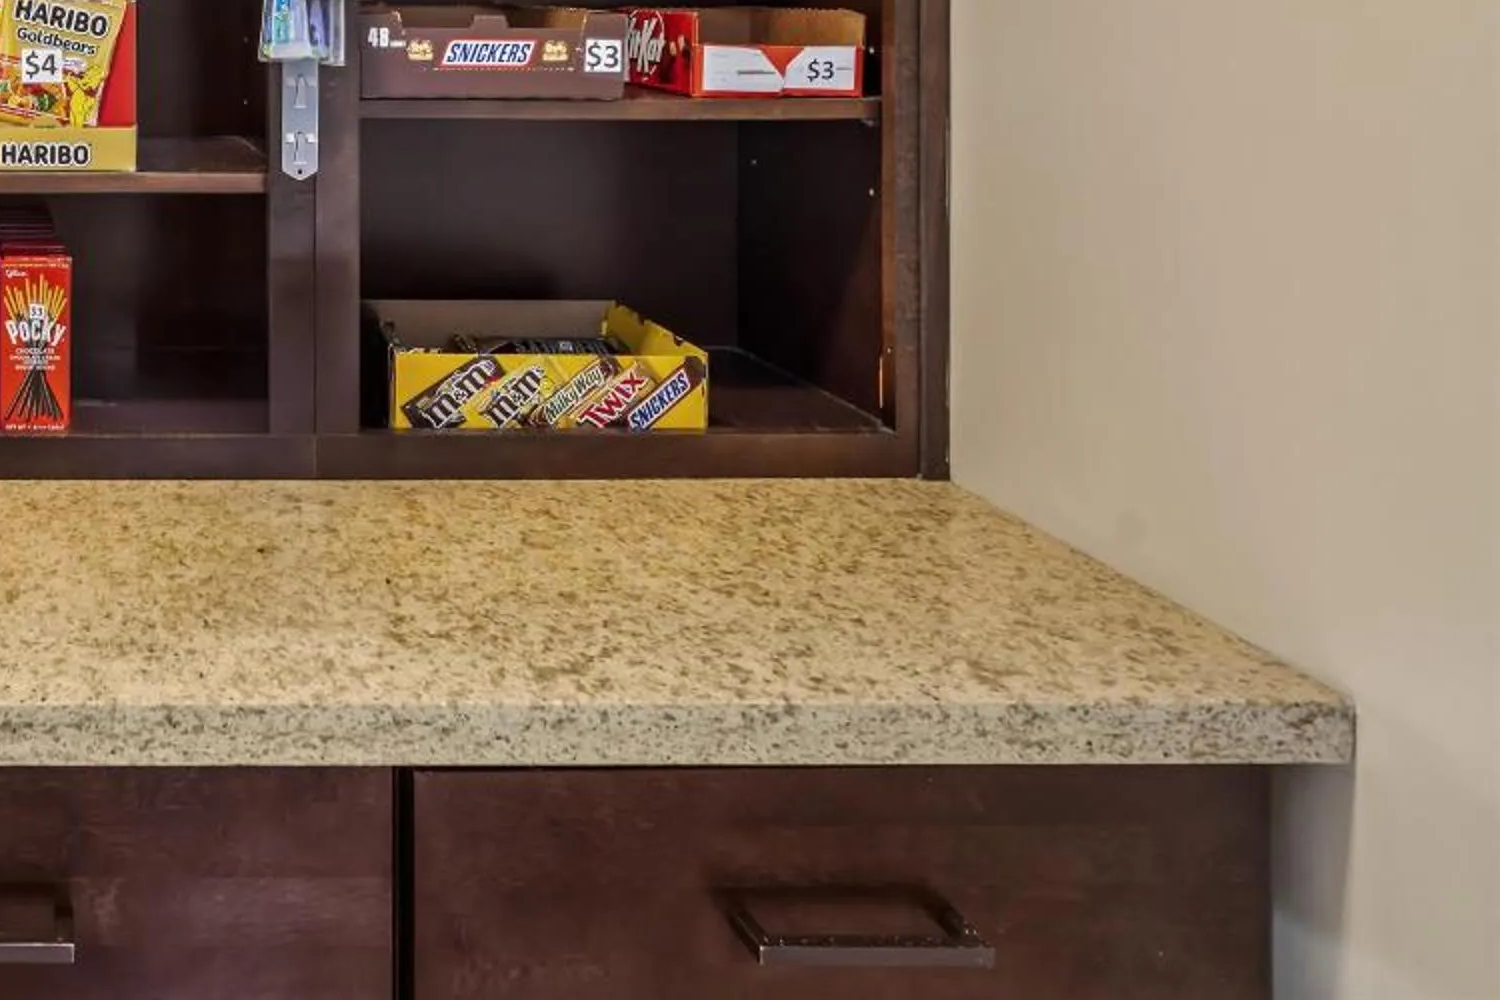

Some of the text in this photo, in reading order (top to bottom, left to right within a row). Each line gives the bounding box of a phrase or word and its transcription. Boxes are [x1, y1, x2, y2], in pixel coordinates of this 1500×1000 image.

[17, 27, 97, 55] Goldbears
[446, 43, 532, 64] SNICKERS
[25, 50, 58, 79] $4
[587, 43, 620, 71] $3
[807, 58, 835, 83] $3
[1, 144, 90, 165] HARIBO
[5, 314, 67, 347] POCKY
[627, 372, 691, 432] SNICKERS
